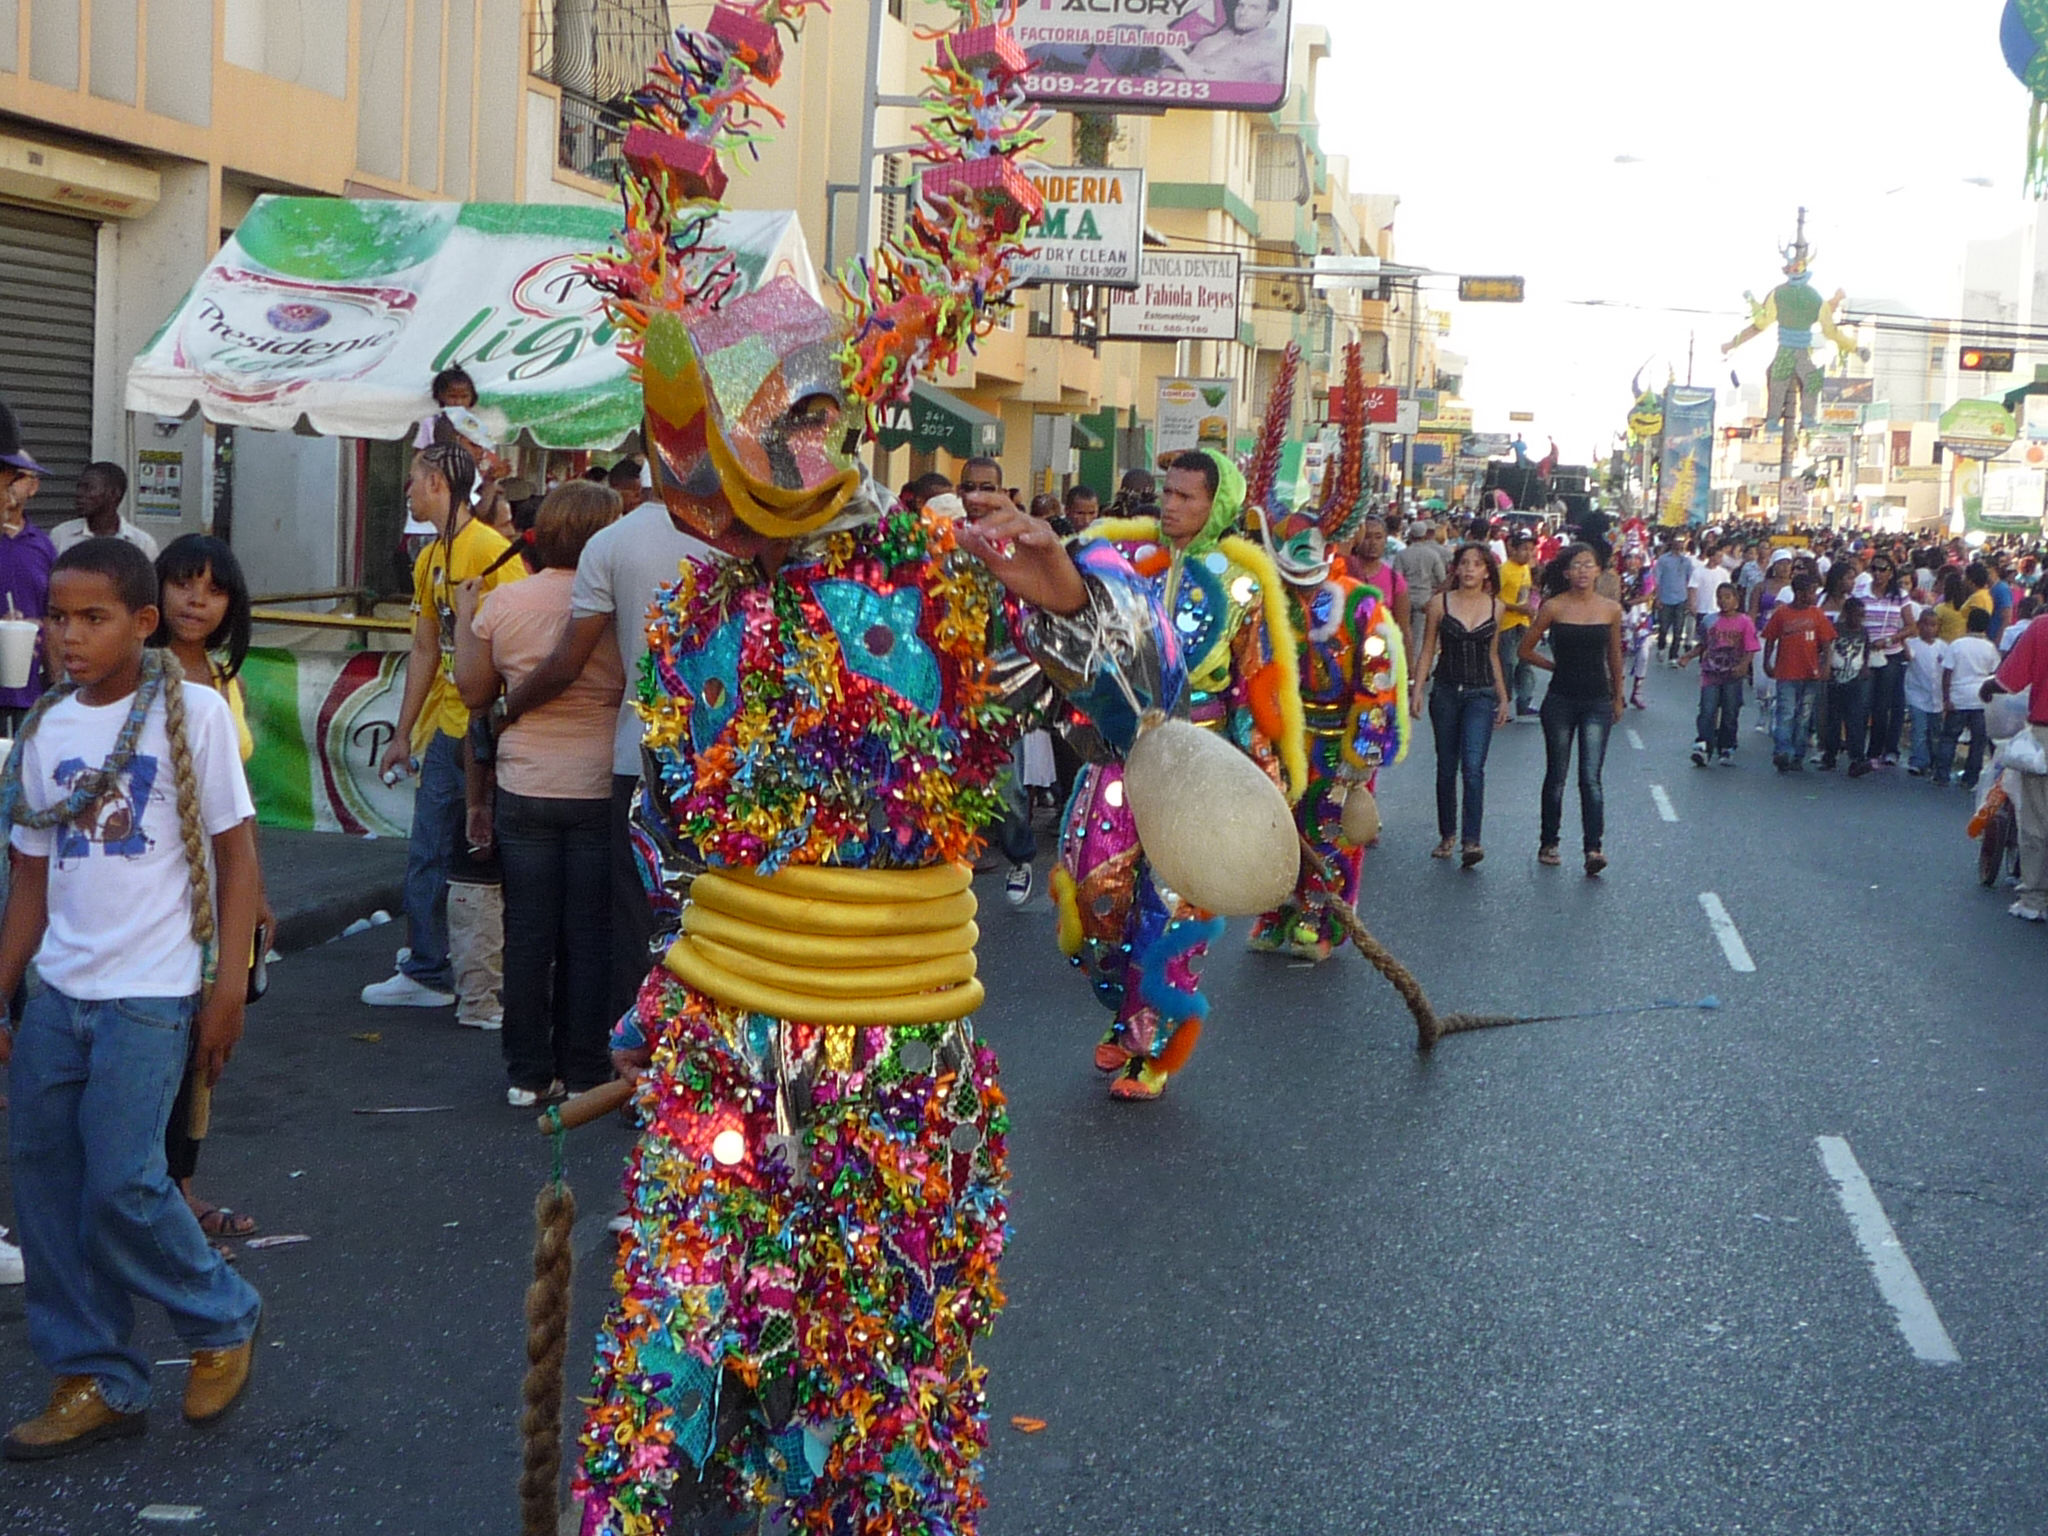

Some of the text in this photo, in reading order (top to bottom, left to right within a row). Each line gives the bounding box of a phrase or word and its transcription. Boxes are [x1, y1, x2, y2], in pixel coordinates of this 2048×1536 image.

[1020, 27, 1091, 43] FACTORIA
[1095, 29, 1115, 43] DE
[1119, 30, 1138, 45] LA
[1142, 31, 1188, 47] MODA
[1025, 77, 1210, 99] 809-276-8283
[1034, 175, 1123, 204] NDERIA
[1046, 247, 1074, 262] DRY
[1080, 249, 1127, 264] CLEAN
[1140, 256, 1234, 280] LINICA DENTAL
[1145, 283, 1192, 308] Fabiola
[1198, 285, 1234, 314] Reyes
